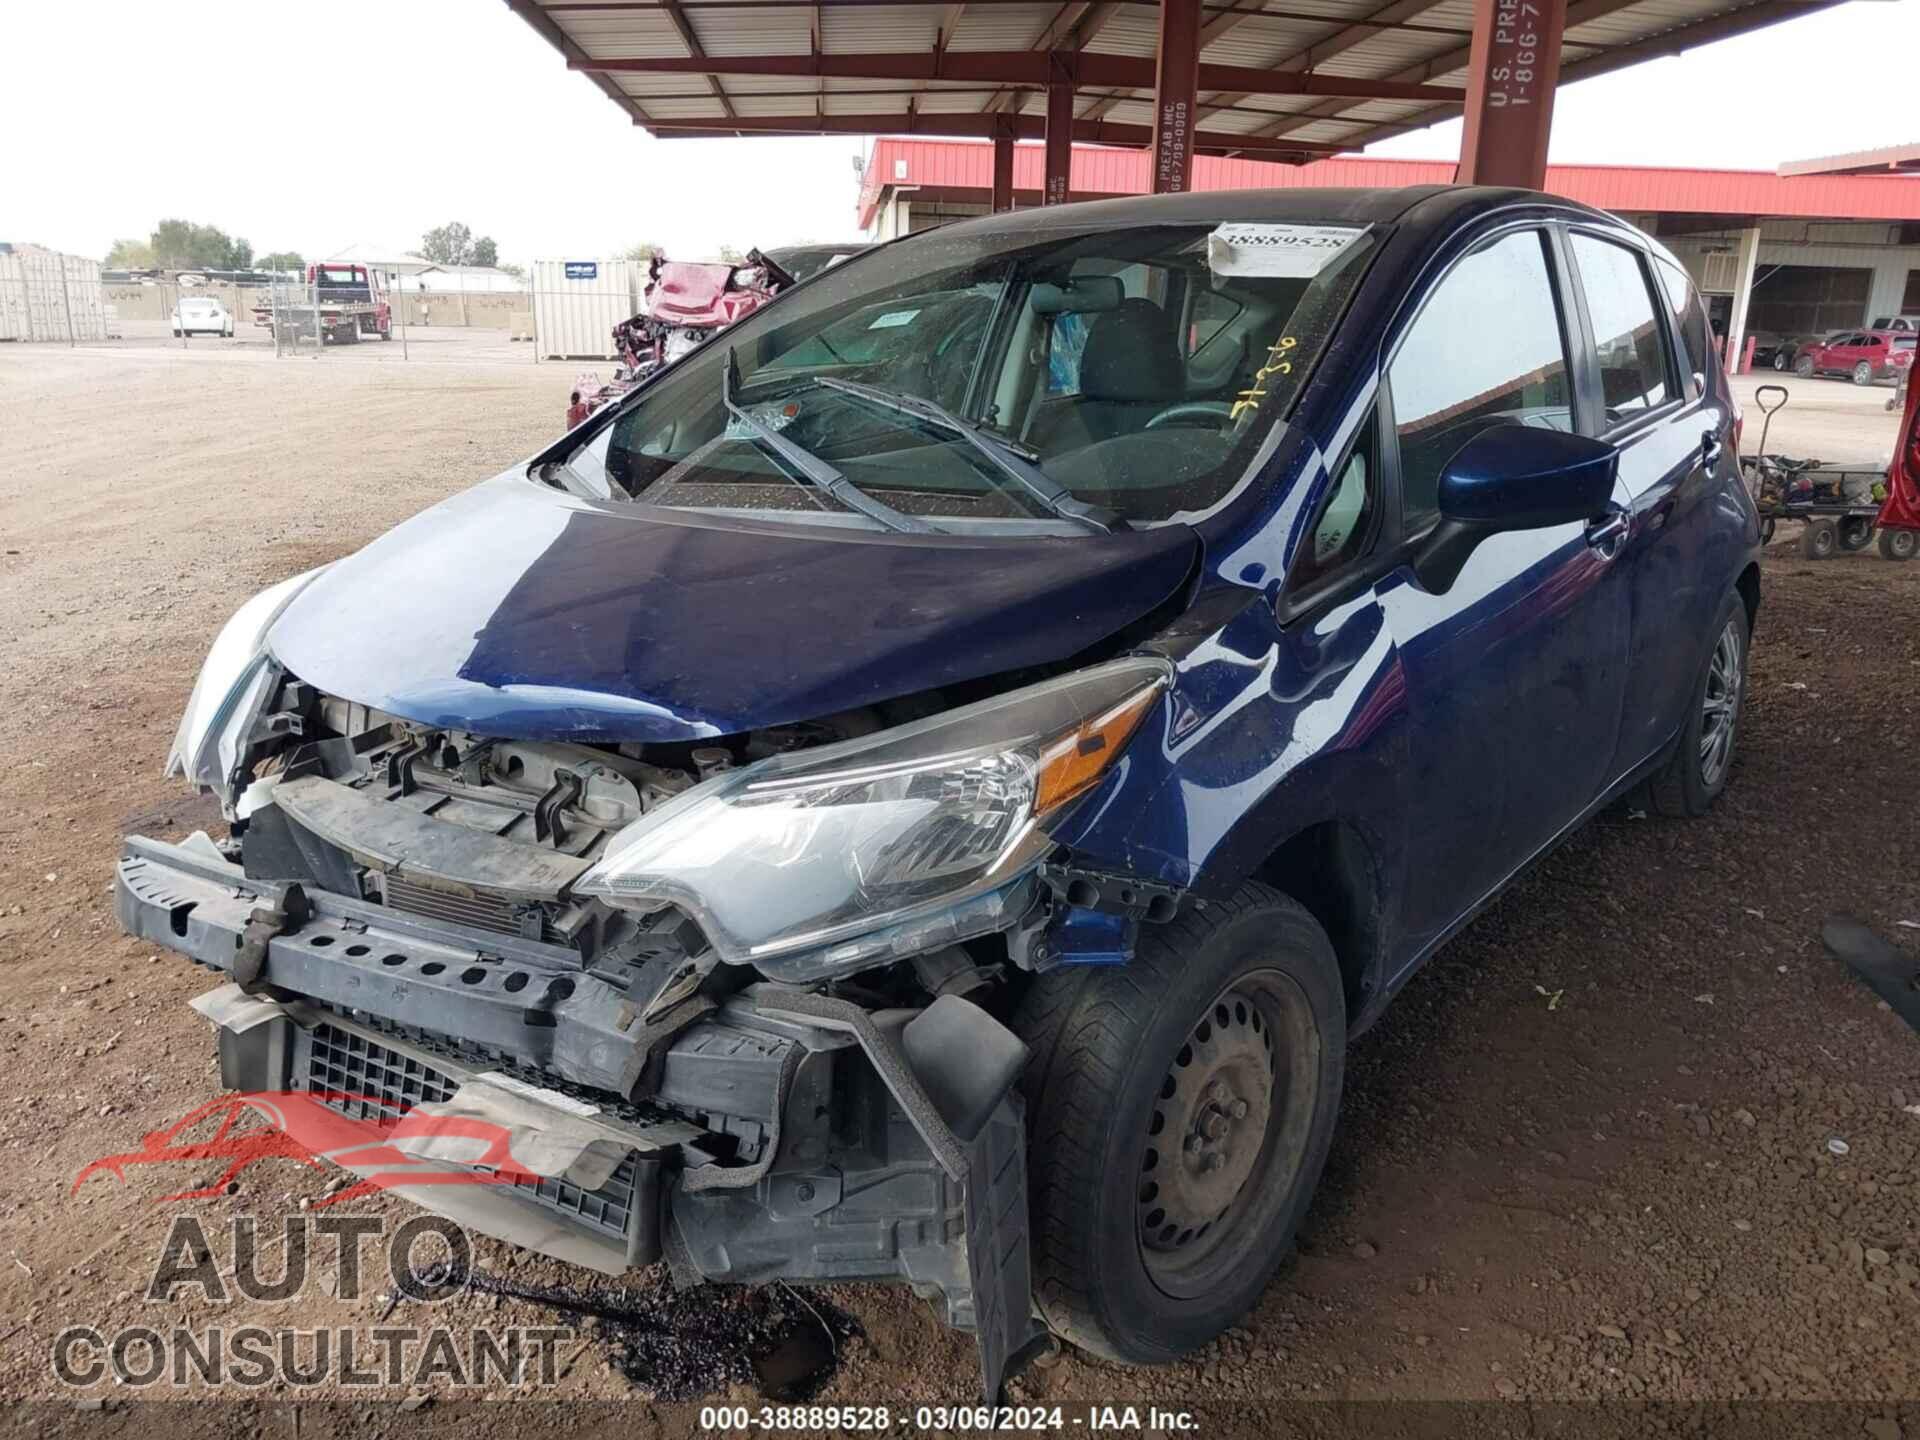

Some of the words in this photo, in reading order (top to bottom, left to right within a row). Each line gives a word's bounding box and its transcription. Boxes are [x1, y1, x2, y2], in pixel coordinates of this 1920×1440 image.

[1490, 59, 1512, 107] U.S.
[1164, 102, 1176, 125] INC.
[1160, 131, 1174, 181] PREFAB
